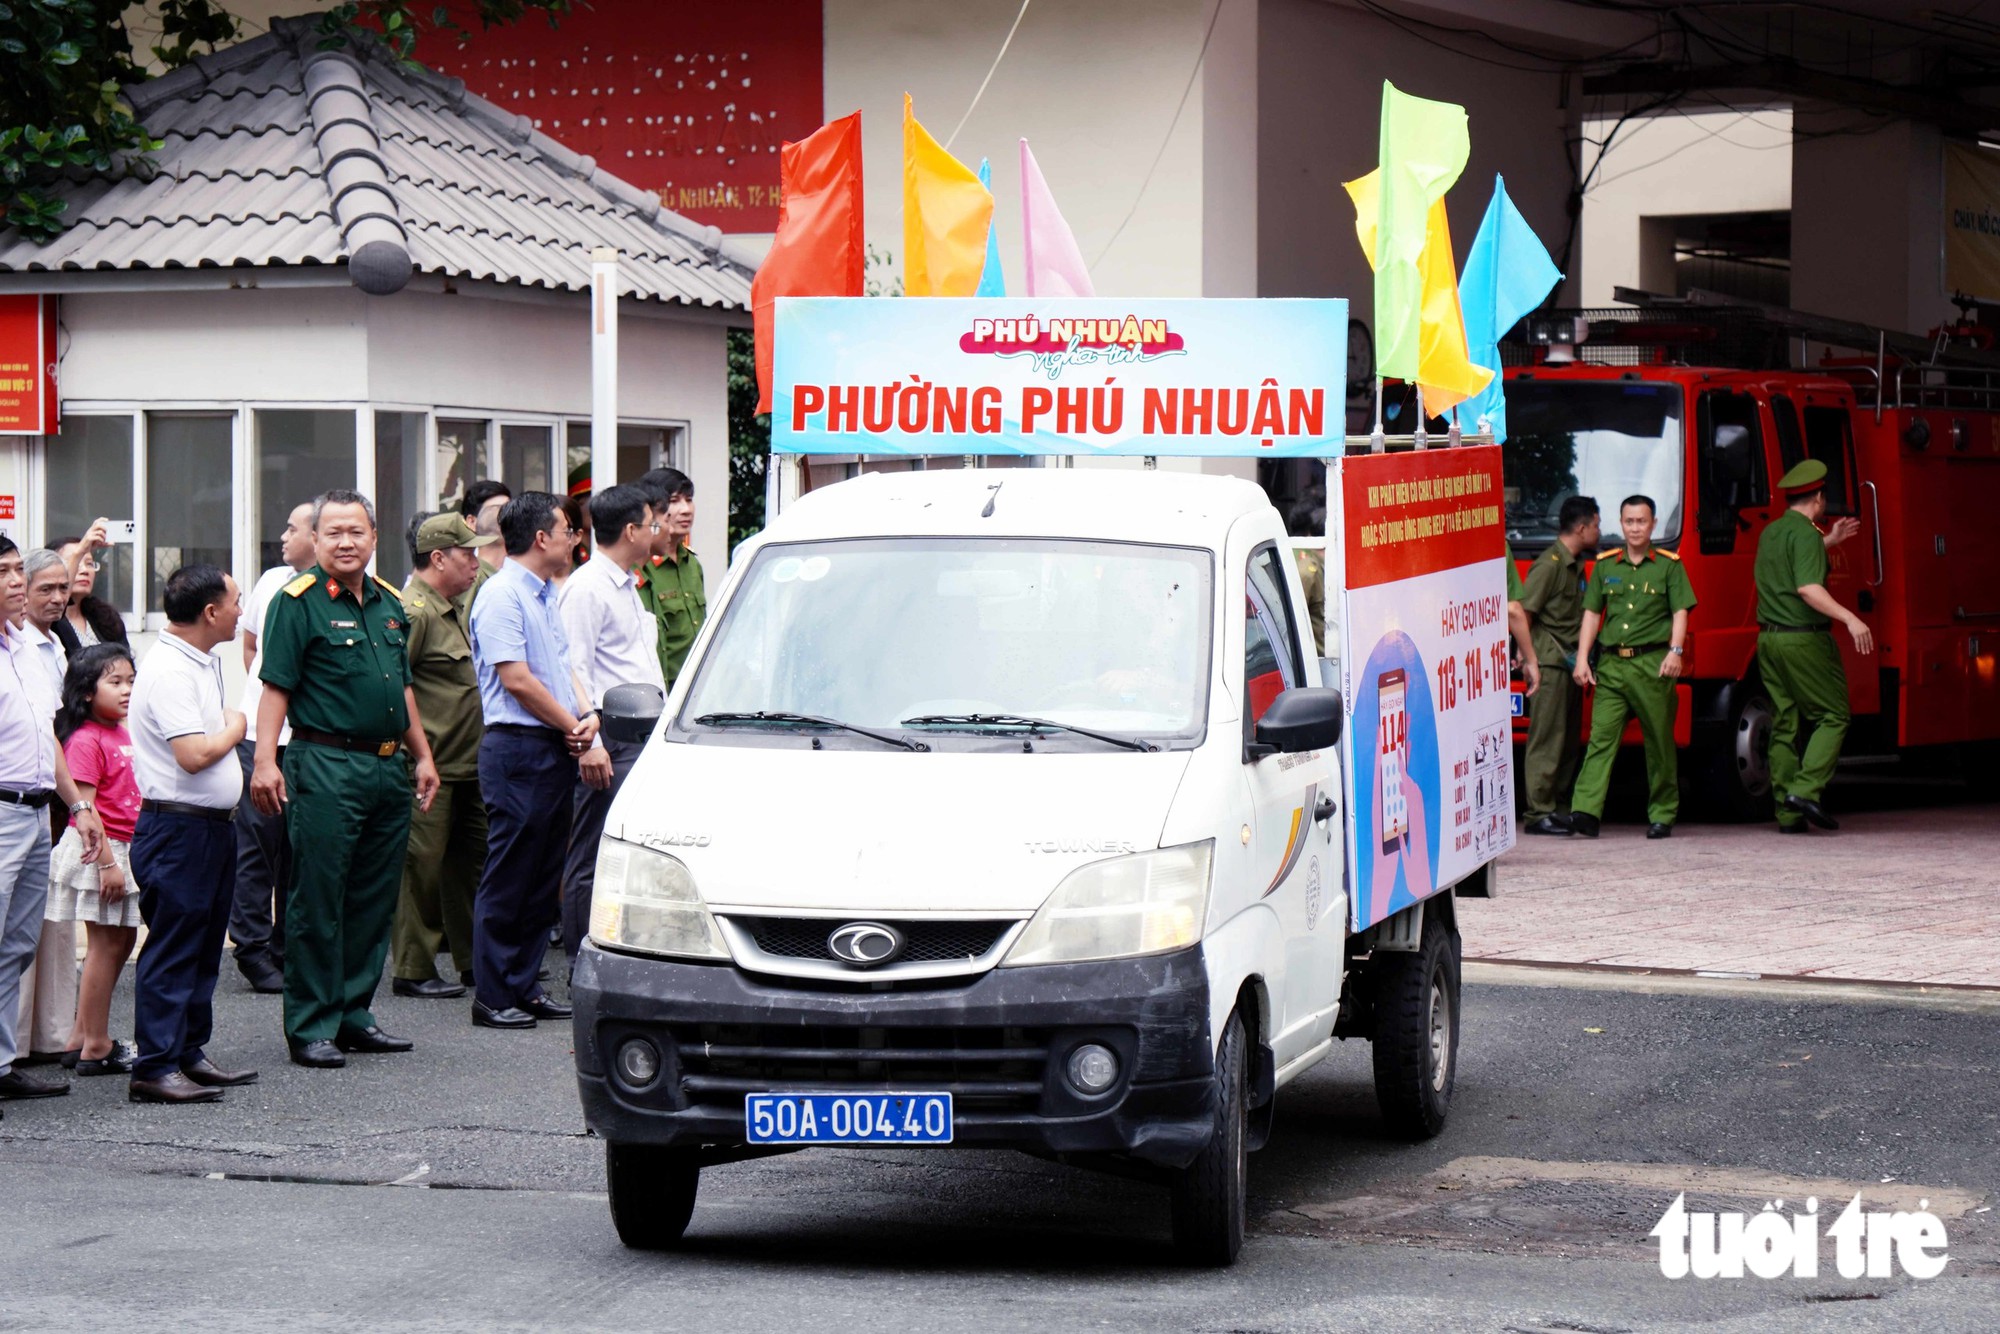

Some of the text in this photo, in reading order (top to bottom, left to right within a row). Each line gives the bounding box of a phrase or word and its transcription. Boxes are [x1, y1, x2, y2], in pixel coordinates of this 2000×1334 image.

[974, 314, 1168, 348] PHÚ NHUẬN
[792, 375, 1325, 446] PHƯỜNG PHÚ NHUẬN
[1442, 594, 1502, 637] HÃY GỌI NGAY
[1437, 655, 1457, 712] 113
[1465, 647, 1483, 701] 114
[1490, 640, 1508, 692] 115
[1382, 711, 1406, 755] 114
[638, 829, 713, 848] THACO
[1024, 838, 1137, 854] TOWNER
[753, 1098, 945, 1138] 50A-004.40
